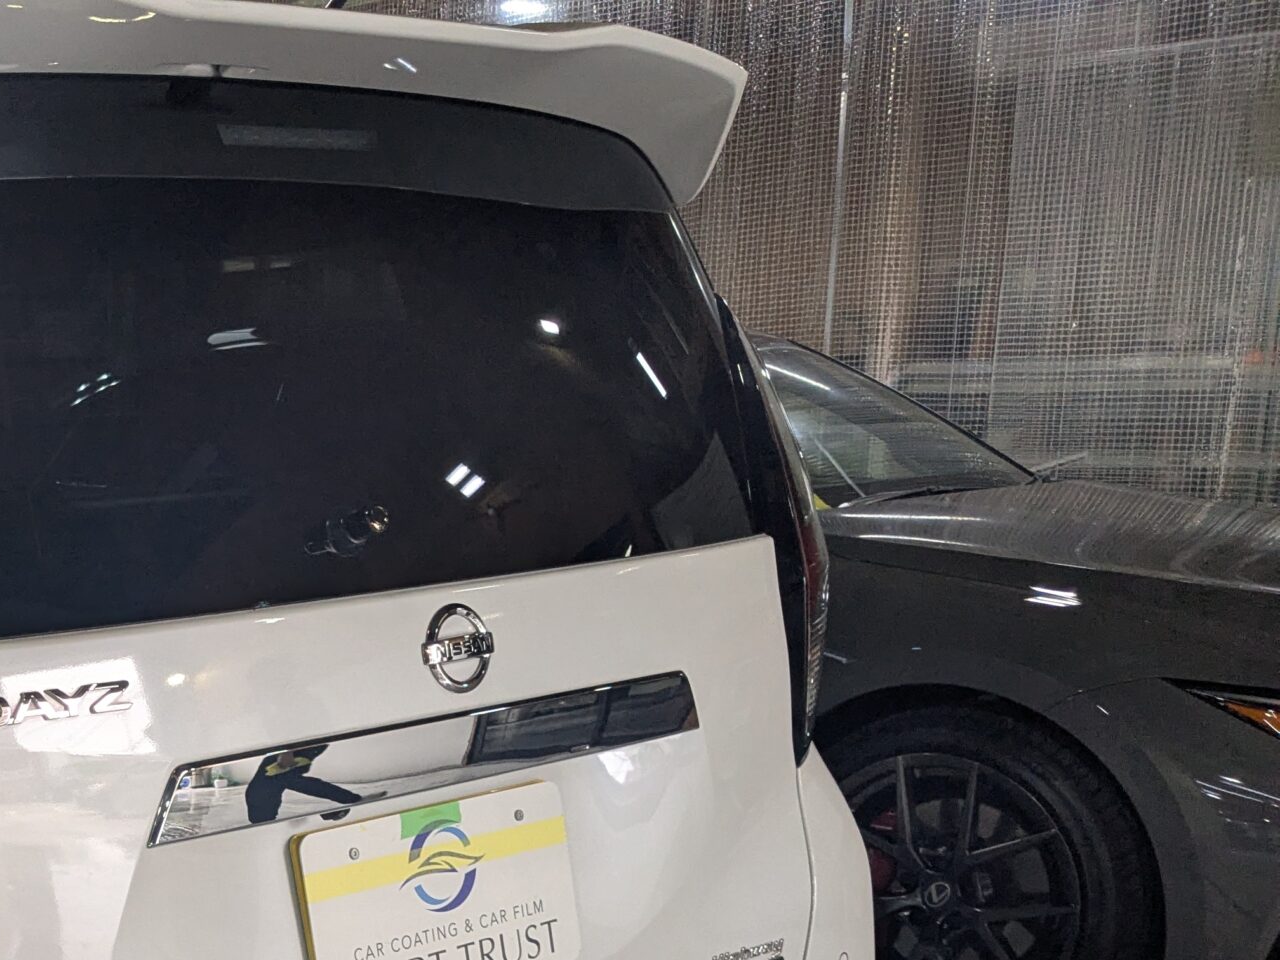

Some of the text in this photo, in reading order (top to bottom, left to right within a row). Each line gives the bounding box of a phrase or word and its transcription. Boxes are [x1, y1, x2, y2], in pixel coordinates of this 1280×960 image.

[432, 632, 493, 660] NISSAN
[390, 922, 458, 952] COATING
[464, 918, 474, 932] &
[479, 909, 507, 929] CAR
[513, 899, 544, 921] FILM
